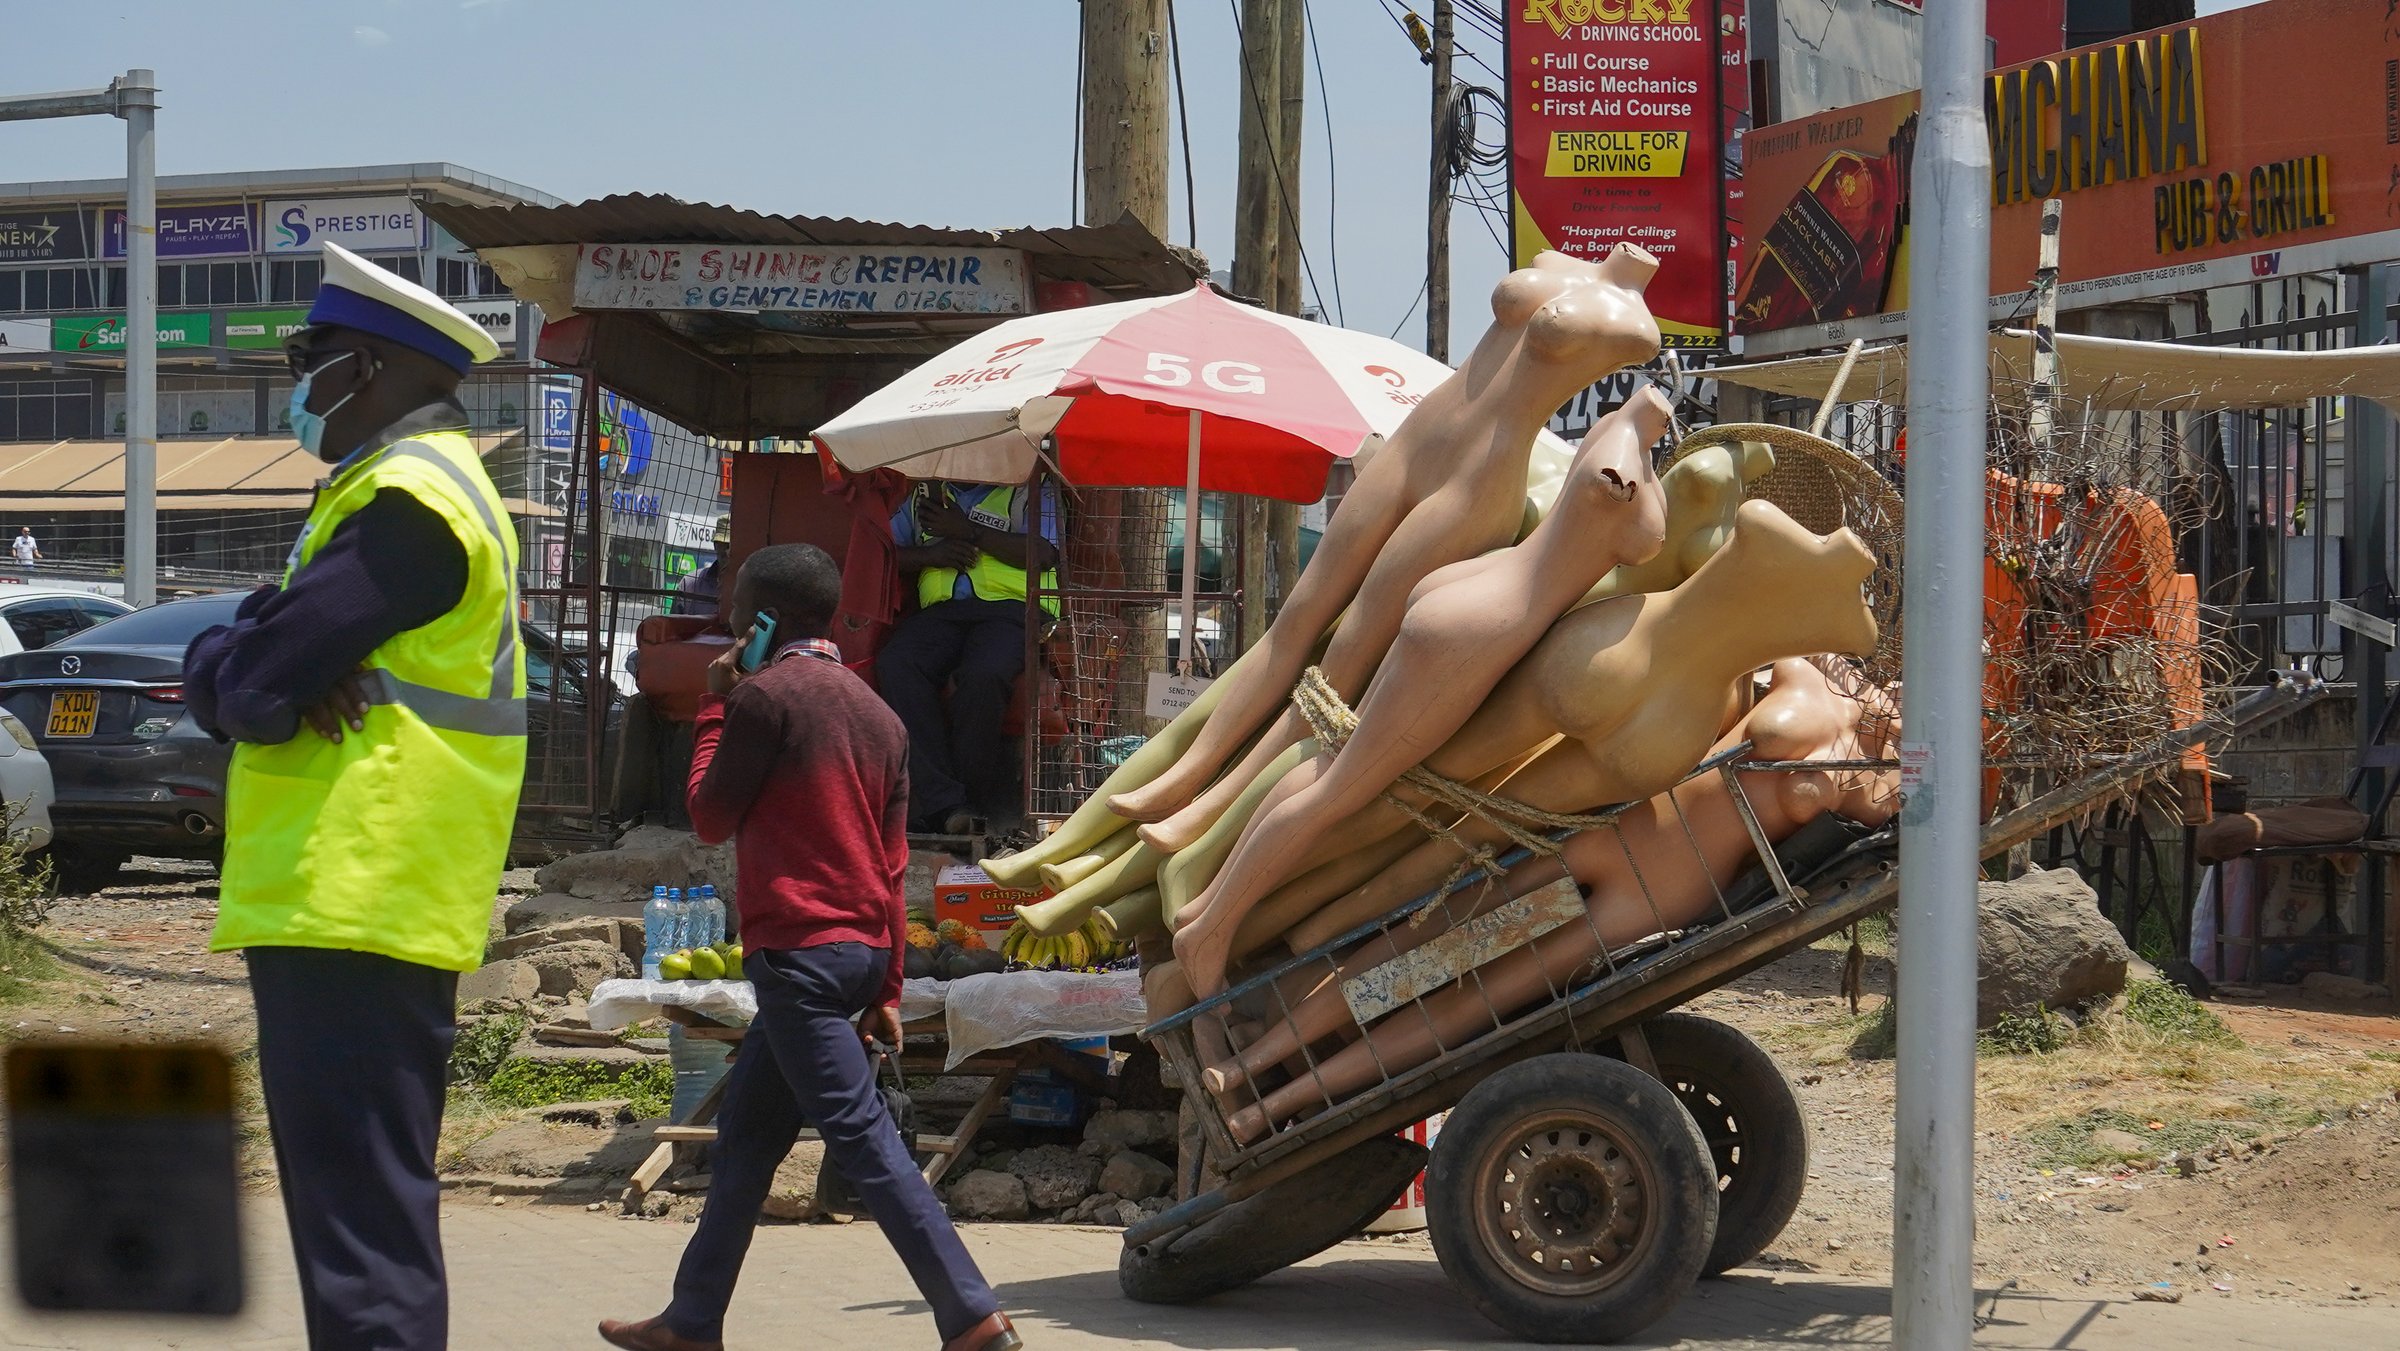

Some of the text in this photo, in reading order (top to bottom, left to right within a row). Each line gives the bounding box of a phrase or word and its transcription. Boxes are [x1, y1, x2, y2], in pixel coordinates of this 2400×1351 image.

[1581, 26, 1702, 42] DRIVING SCHOOL
[1543, 53, 1649, 71] Full Course
[1543, 75, 1698, 94] Basic Mechanics
[1543, 99, 1692, 117] First Aid Course
[1557, 132, 1679, 151] ENROLL FOR
[1573, 154, 1651, 172] DRIVING
[1605, 186, 1633, 197] time
[1637, 186, 1652, 197] to
[1571, 202, 1663, 212] Drive Forward
[2154, 155, 2336, 255] PUB & GRILL
[159, 216, 248, 234] PLAYZA
[315, 213, 414, 233] PRESTIGE
[1627, 225, 1677, 240] Ceilings
[1793, 200, 1821, 234] JOHNNIE
[1820, 229, 1846, 266] WALKER
[1560, 242, 1583, 253] Are
[591, 246, 681, 283] SHOE
[698, 249, 826, 285] SHINE
[854, 255, 982, 286] REPAIR
[2251, 252, 2281, 277] UDV
[2070, 282, 2086, 294] SALE
[2085, 281, 2094, 291] TO
[2094, 276, 2121, 290] PERSONS
[2121, 273, 2142, 286] UNDER
[2142, 271, 2155, 282] THE
[2155, 269, 2168, 281] AGE
[2168, 268, 2178, 279] OF
[708, 286, 878, 311] GENTLEMEN
[1879, 311, 1907, 325] EXCESSIVE
[1682, 335, 1717, 347] 222
[933, 363, 1024, 388] airtel
[1142, 352, 1266, 395] 5G
[971, 511, 1006, 530] POLICE
[1168, 686, 1186, 696] SEND
[62, 693, 94, 713] KDU
